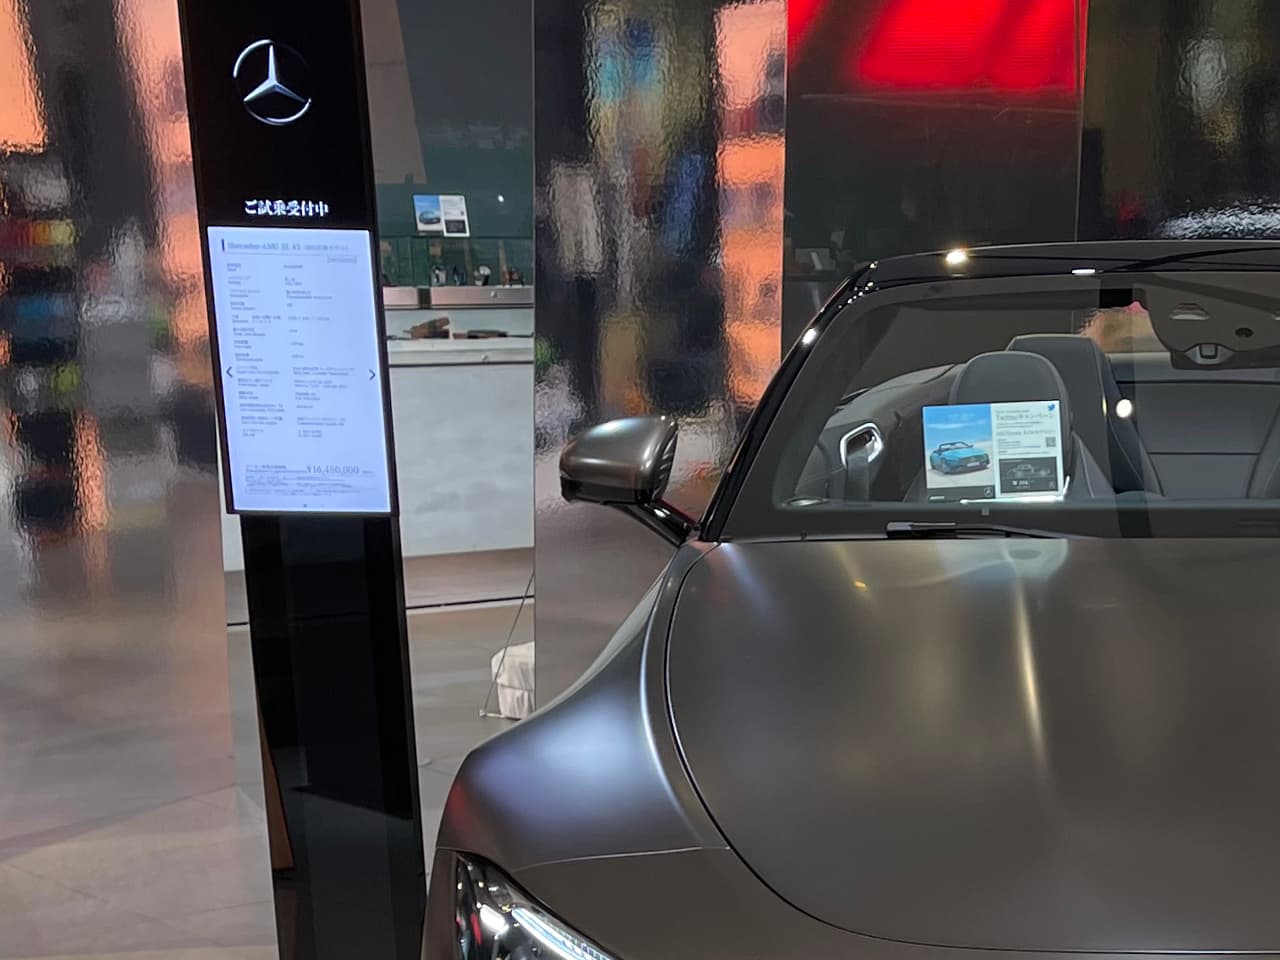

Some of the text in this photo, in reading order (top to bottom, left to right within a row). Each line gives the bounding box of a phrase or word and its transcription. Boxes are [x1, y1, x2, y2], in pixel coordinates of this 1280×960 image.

[245, 199, 329, 217] ご試乗受付中
